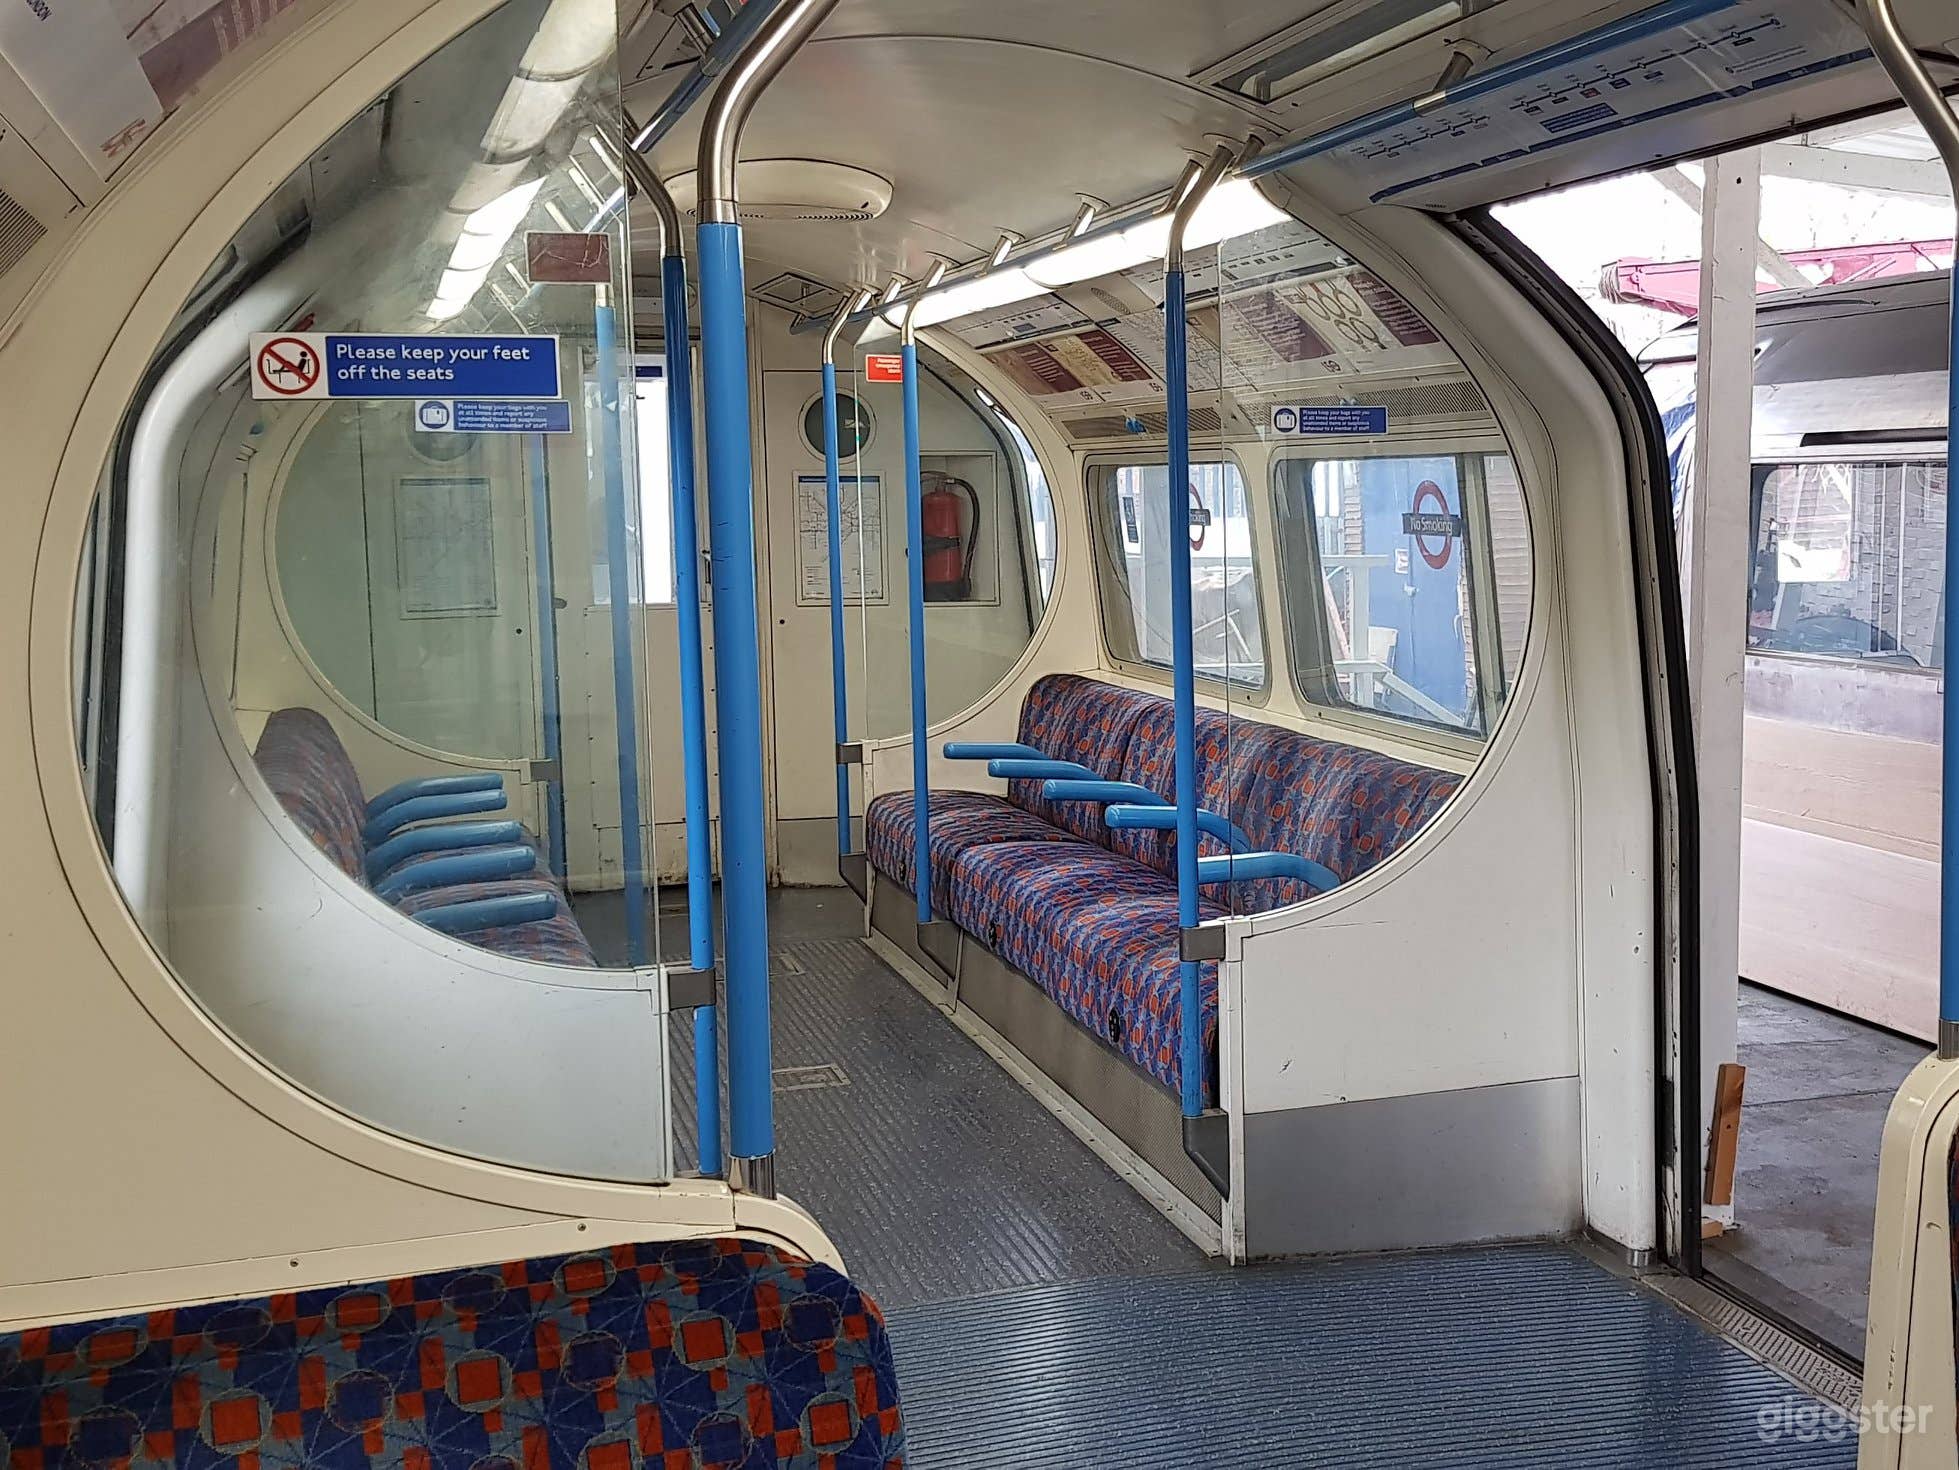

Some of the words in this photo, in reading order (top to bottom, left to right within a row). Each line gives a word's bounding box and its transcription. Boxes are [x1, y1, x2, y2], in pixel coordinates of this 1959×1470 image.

[336, 343, 396, 359] Please
[401, 344, 444, 363] keep
[448, 348, 488, 363] your
[492, 345, 530, 360] feet
[337, 364, 366, 379] off
[370, 365, 401, 379] the
[406, 367, 454, 380] seats
[1410, 516, 1421, 531] No
[1420, 516, 1453, 536] Smoking
